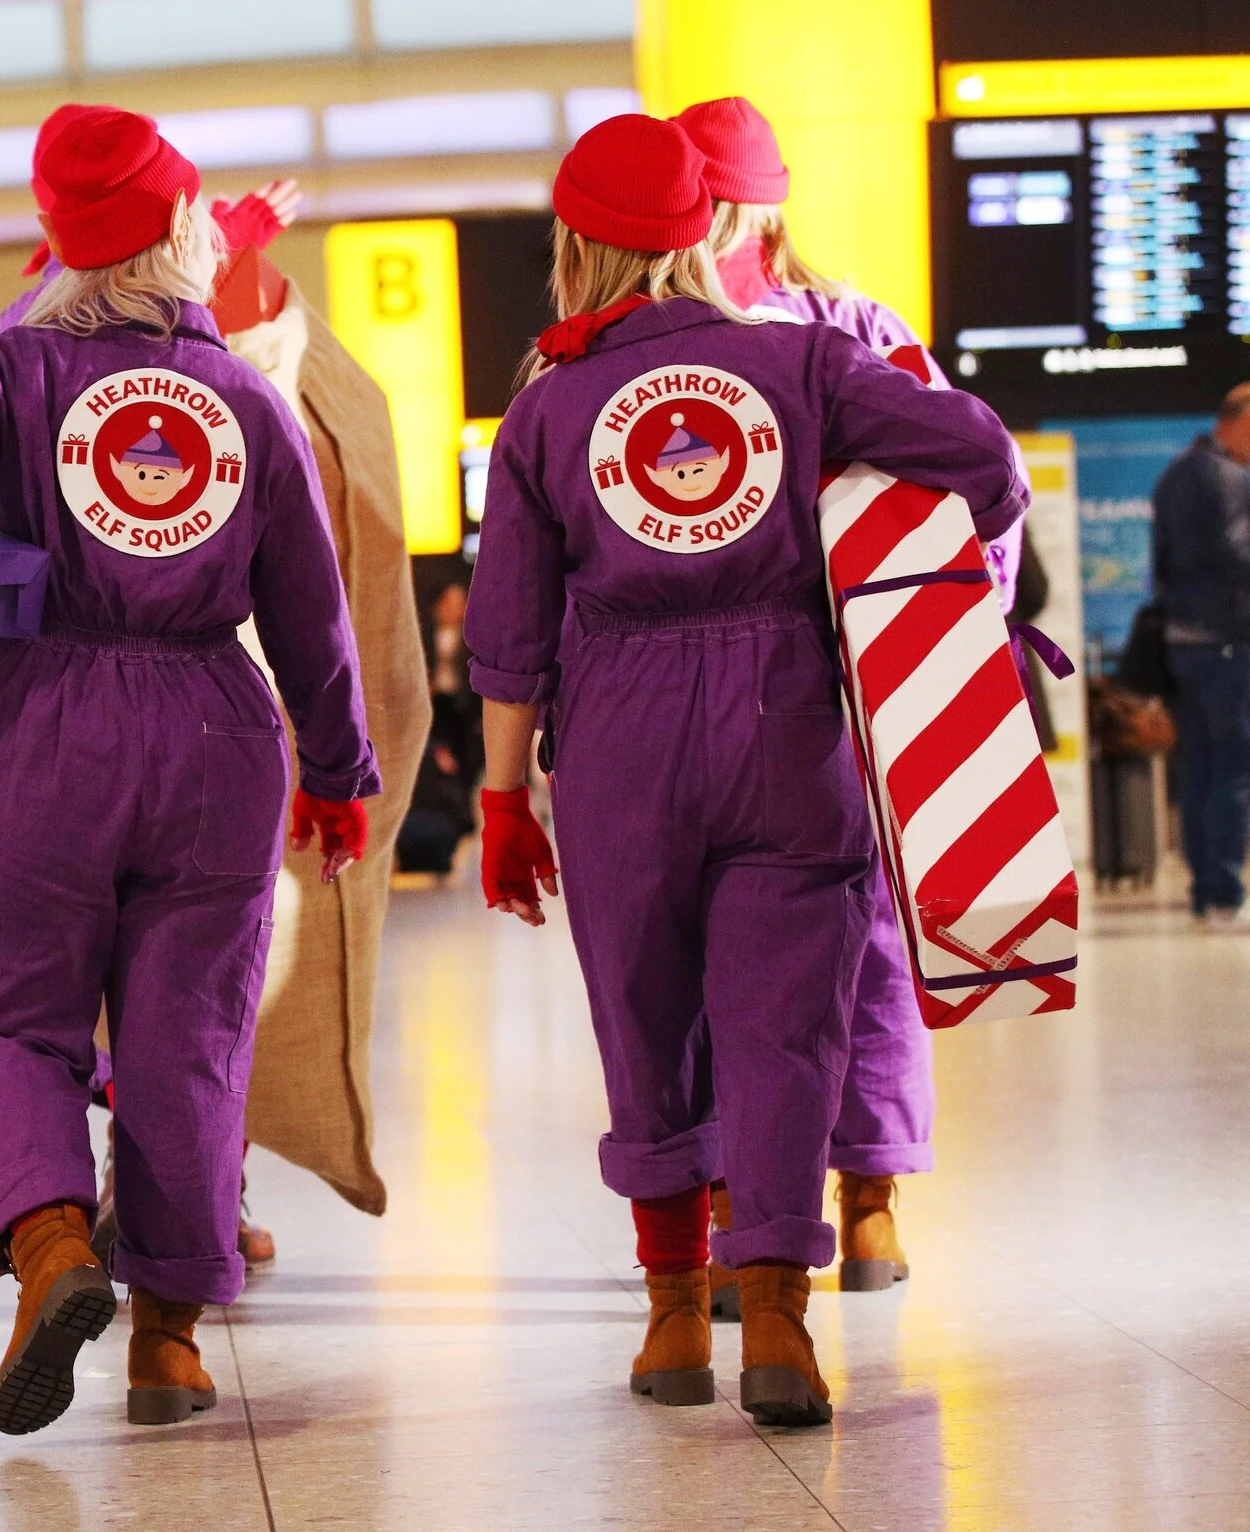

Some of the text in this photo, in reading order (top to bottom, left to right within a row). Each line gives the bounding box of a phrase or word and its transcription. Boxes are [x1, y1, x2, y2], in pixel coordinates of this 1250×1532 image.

[368, 250, 422, 322] B
[86, 377, 228, 429] HEATHROW
[604, 373, 747, 433] HEATHROW
[84, 501, 212, 552] ELF SQUAD
[637, 485, 765, 544] ELF SQUAD
